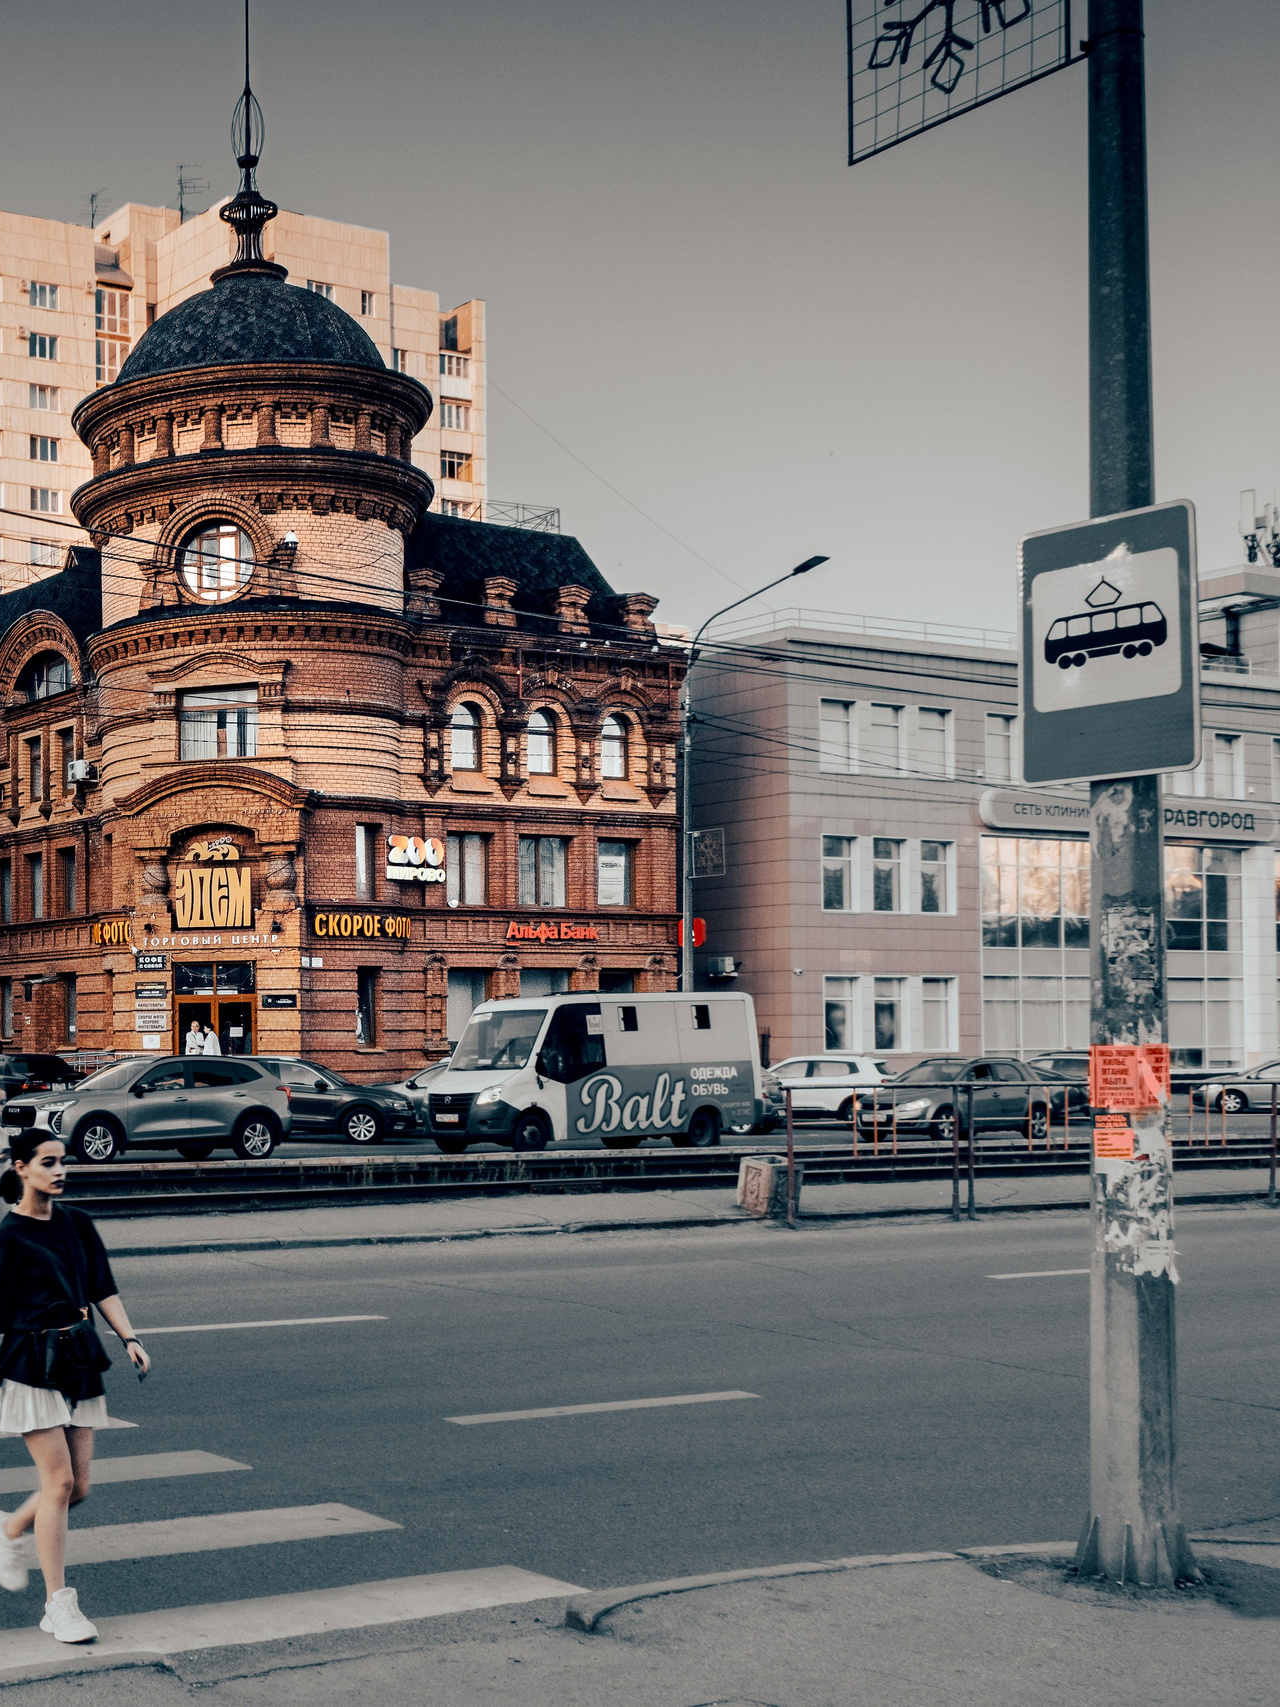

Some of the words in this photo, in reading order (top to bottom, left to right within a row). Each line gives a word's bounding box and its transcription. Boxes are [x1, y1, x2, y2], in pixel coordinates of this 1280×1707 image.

[1014, 803, 1042, 816] СЕТЬ
[387, 866, 446, 882] МИРОВО
[176, 867, 251, 928] ЭДЕМ
[315, 914, 380, 936] СКОРОЕ
[385, 916, 411, 938] ФОТО
[506, 921, 558, 944] Альфа
[561, 922, 599, 940] Банк
[144, 934, 222, 946] ТОРГОВЫЙ
[232, 934, 279, 945] ЦЕНТР
[690, 1066, 738, 1080] ОДЕЖДА
[692, 1083, 729, 1096] ОБУВЬ
[576, 1072, 688, 1133] Balt
